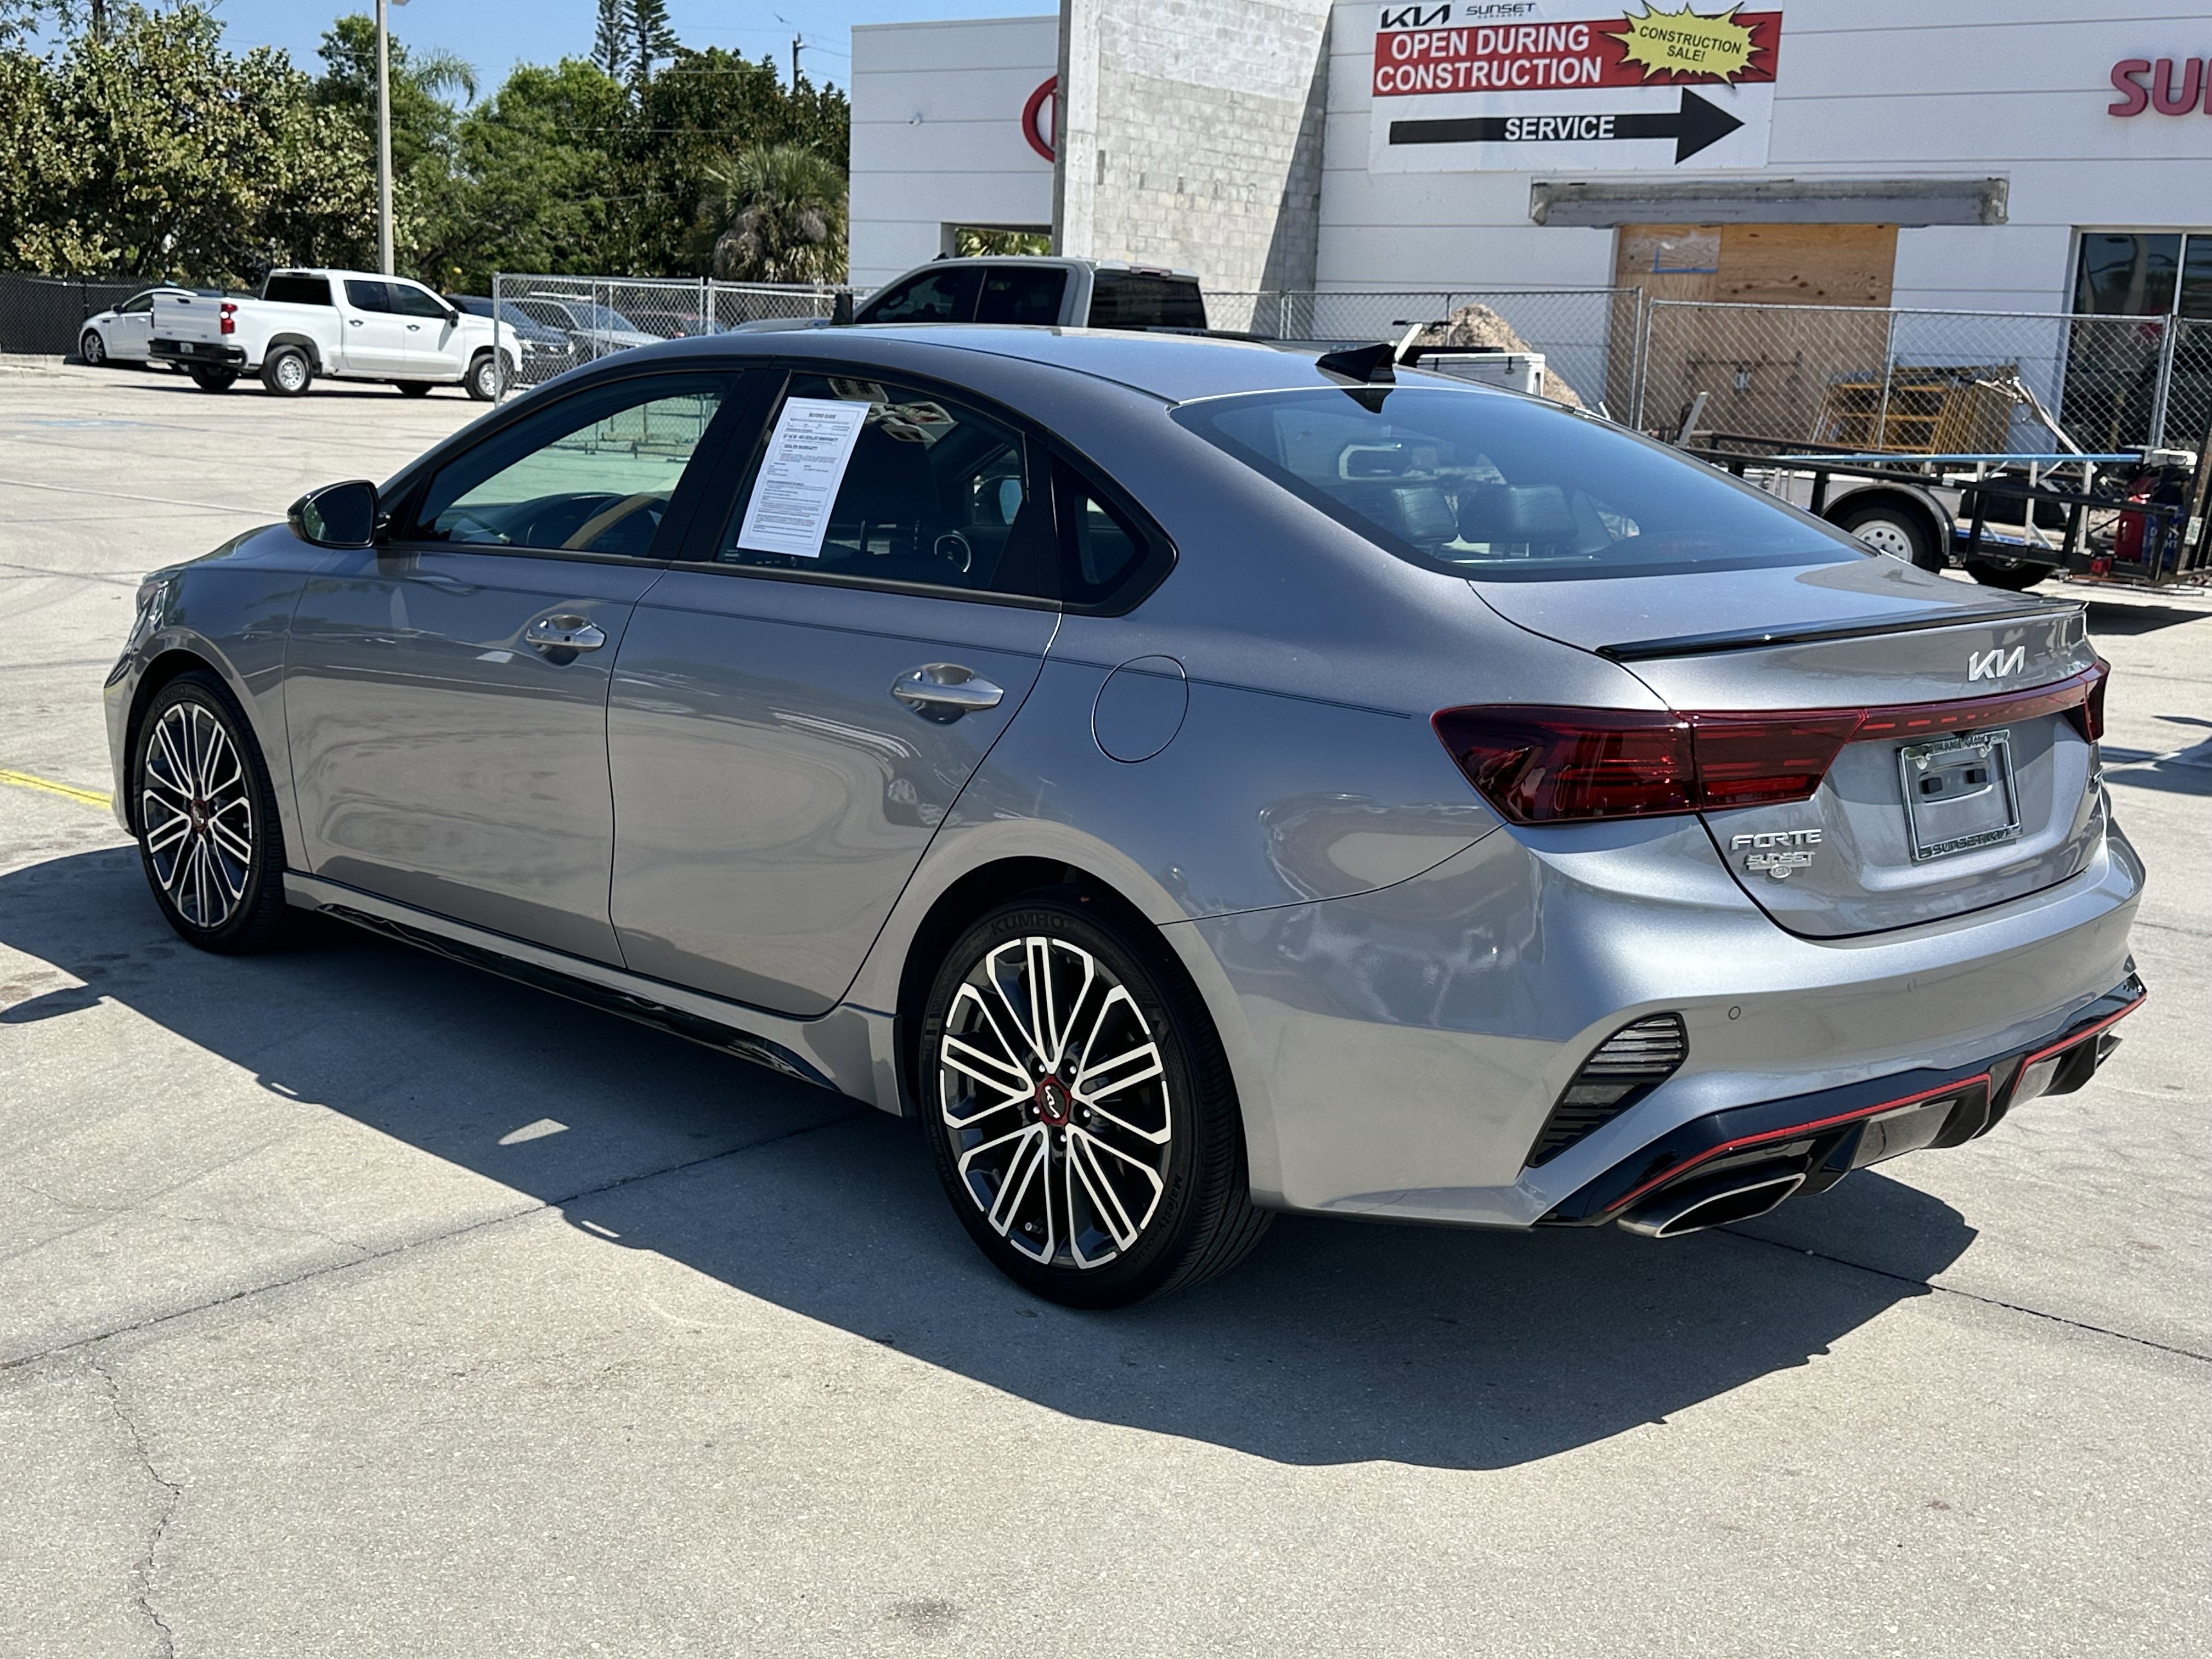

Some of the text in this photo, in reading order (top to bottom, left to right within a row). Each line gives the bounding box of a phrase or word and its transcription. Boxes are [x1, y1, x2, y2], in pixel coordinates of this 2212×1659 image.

[1381, 4, 1451, 29] KIA
[1466, 3, 1536, 15] SUNSET
[1391, 24, 1590, 60] OPEN DURING
[1639, 26, 1741, 54] CONSTRUCTION
[1667, 45, 1706, 62] SALE!
[1376, 57, 1601, 92] CONSTRUCTION
[2108, 57, 2212, 117] SU
[1504, 116, 1616, 140] SERVICE
[1968, 646, 2025, 681] KIA
[1731, 829, 1822, 850] FORTE
[991, 913, 1063, 935] KUMHO
